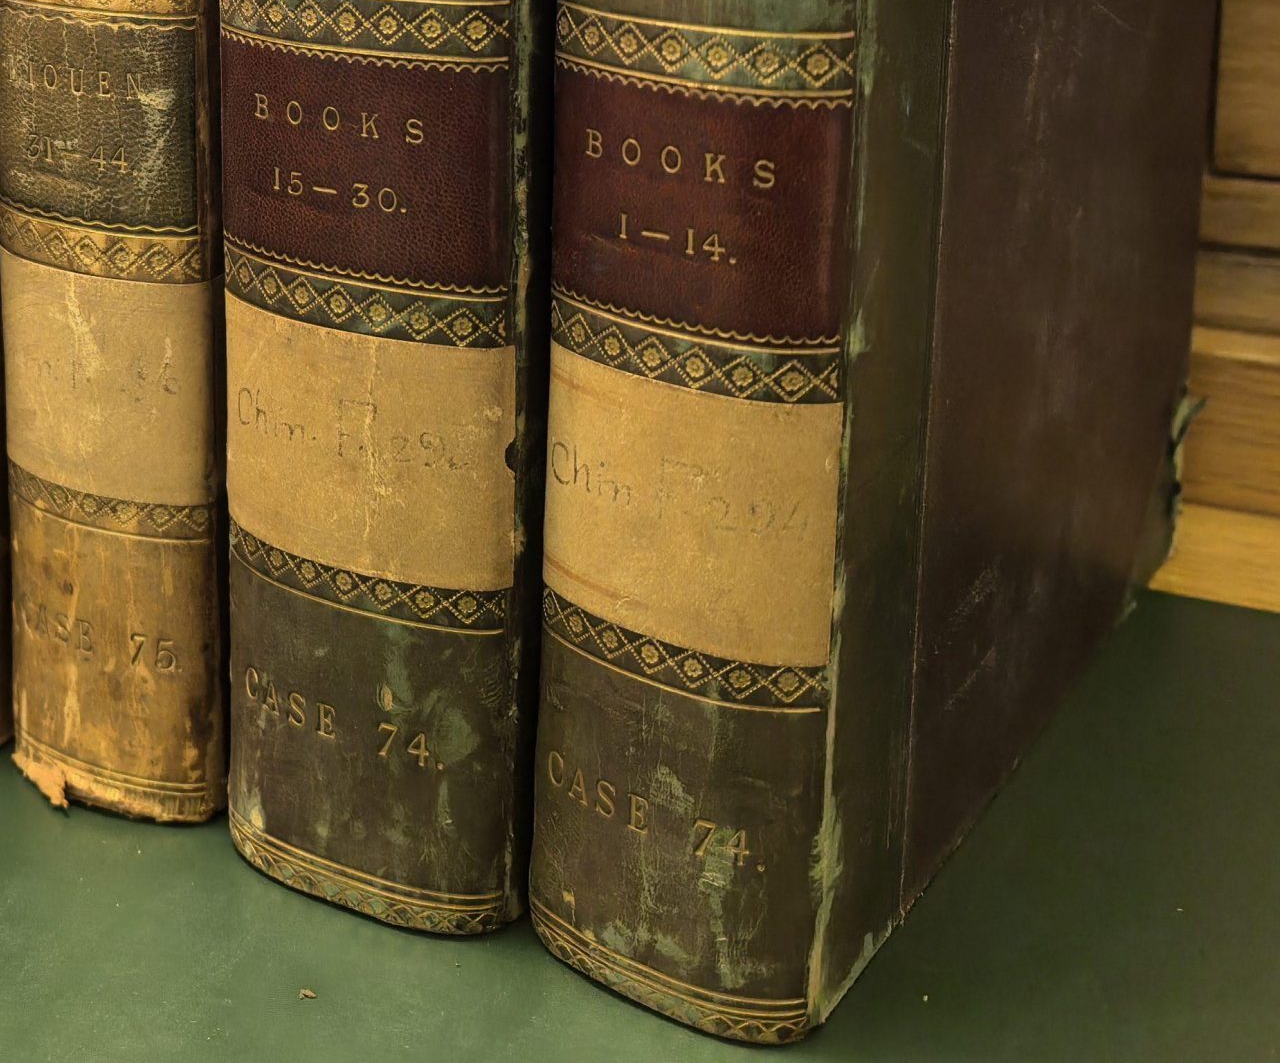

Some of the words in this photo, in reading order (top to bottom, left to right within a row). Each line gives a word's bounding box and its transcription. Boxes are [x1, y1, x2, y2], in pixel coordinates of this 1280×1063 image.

[253, 92, 425, 145] BOOKS
[586, 128, 777, 190] BOOKS
[244, 666, 337, 740] CASE
[377, 722, 445, 771] 74.
[547, 749, 651, 837] CASE
[691, 819, 767, 874] 74.
